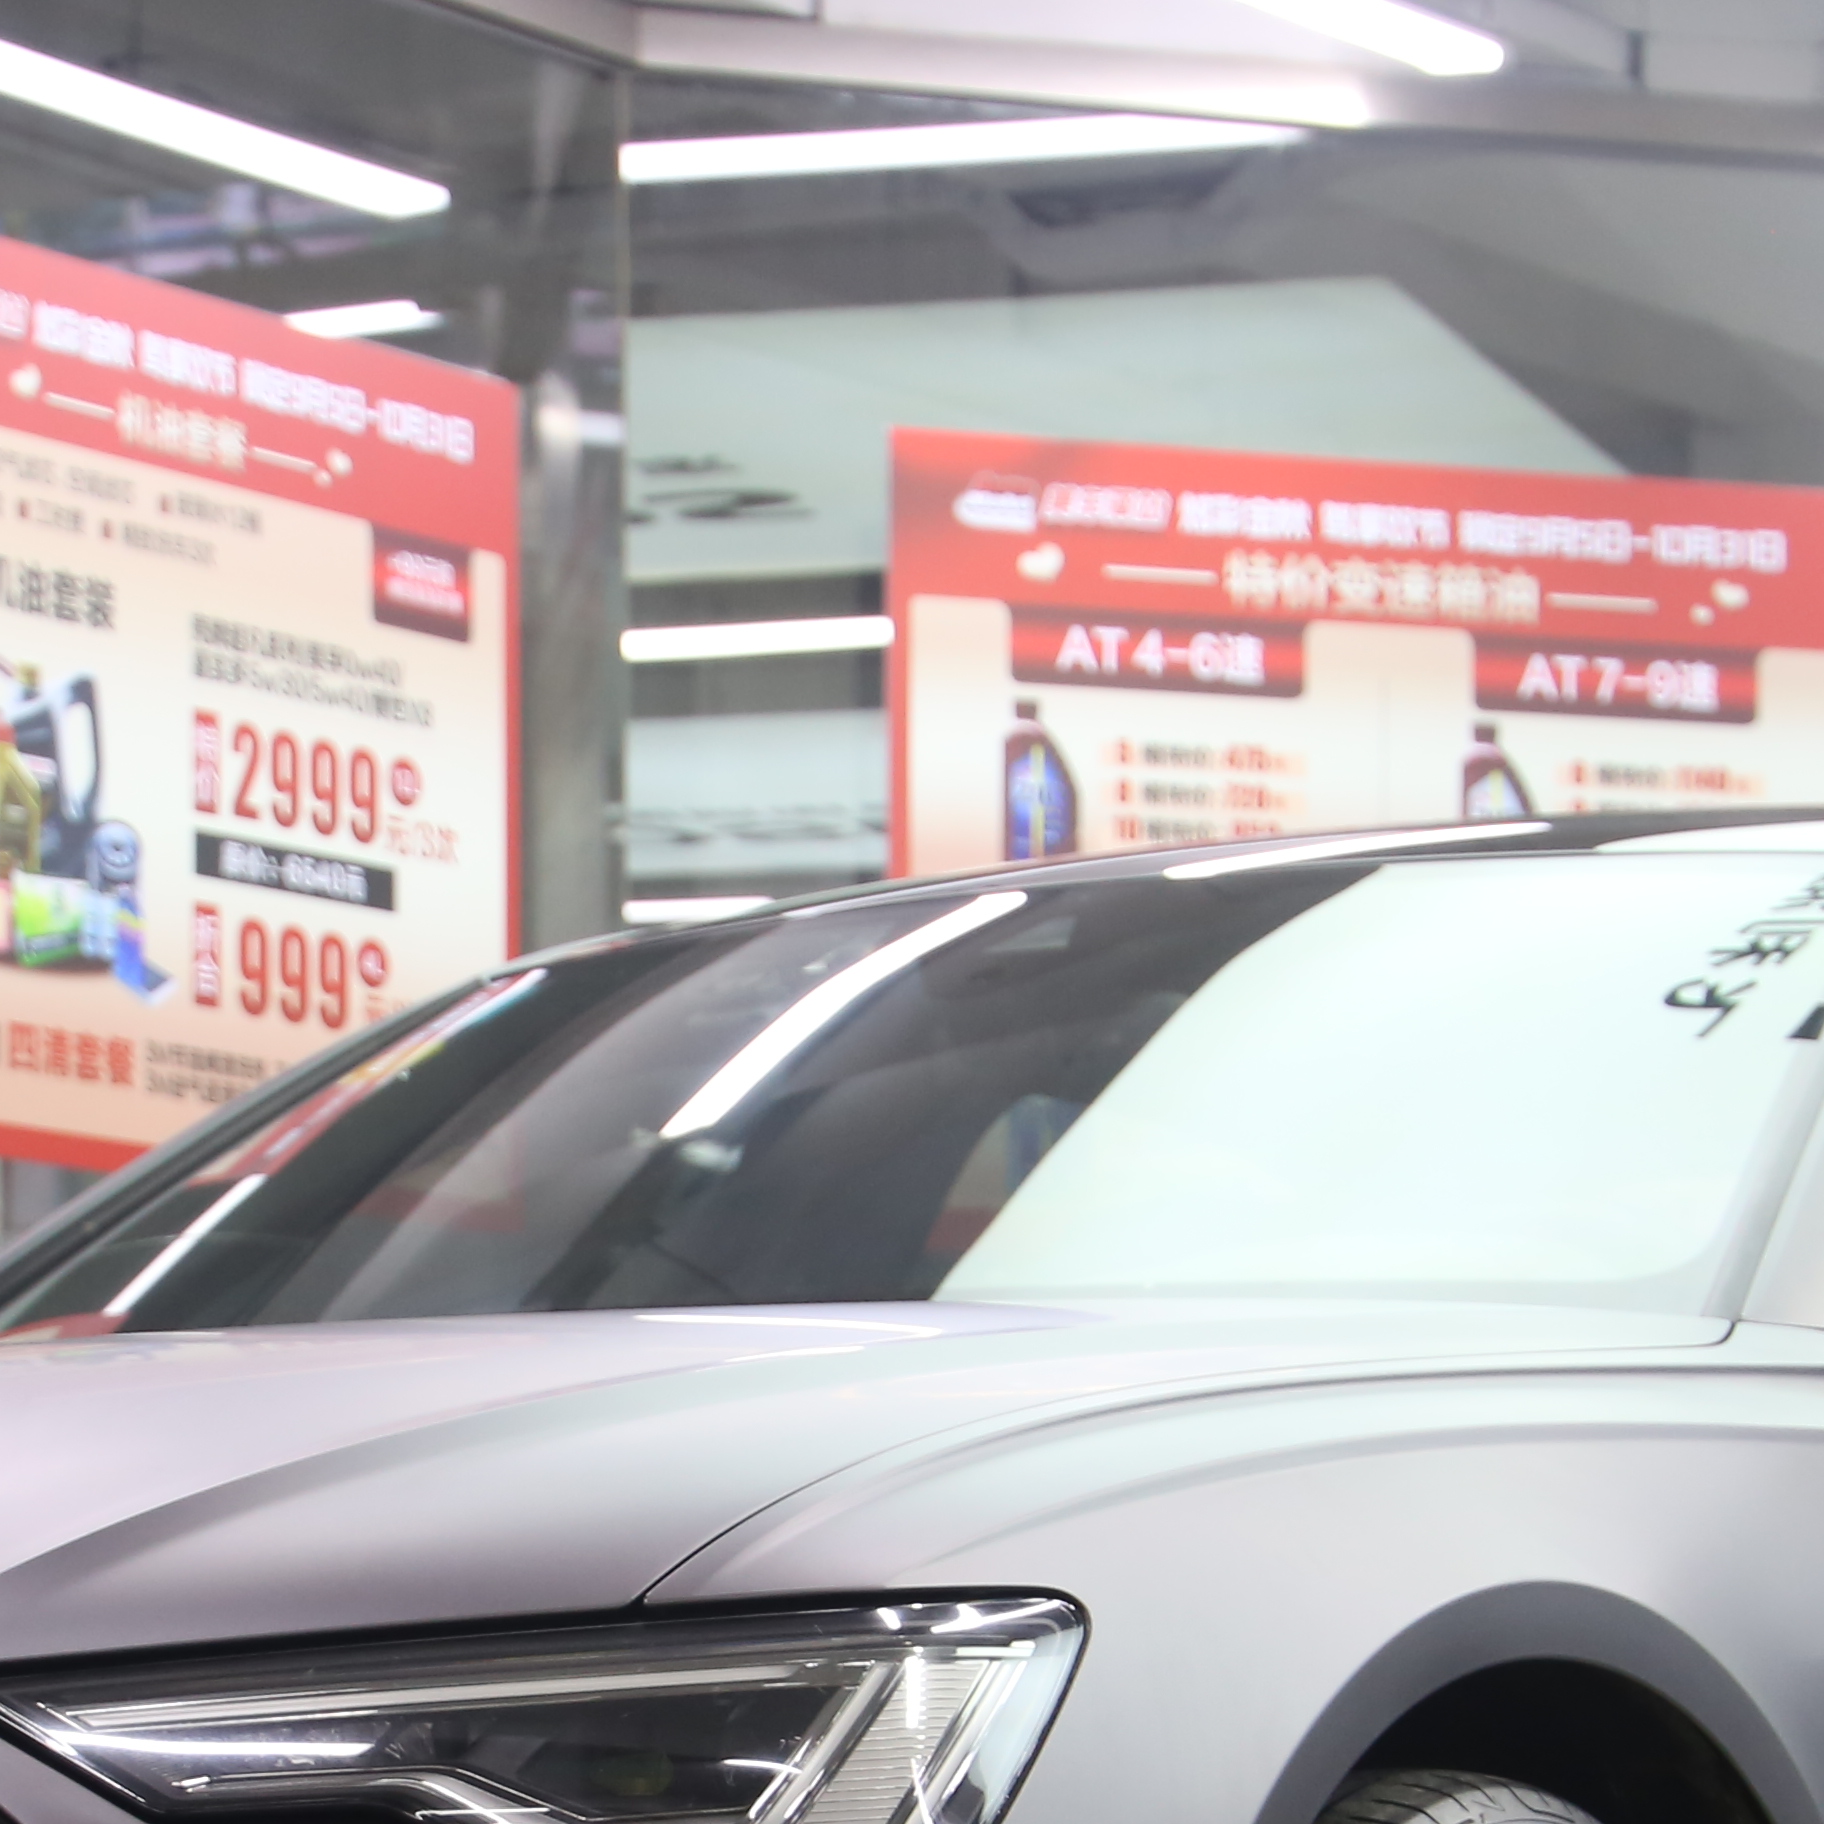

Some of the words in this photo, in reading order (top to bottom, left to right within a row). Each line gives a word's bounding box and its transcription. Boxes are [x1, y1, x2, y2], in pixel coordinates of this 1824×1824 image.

[113, 391, 248, 474] 机油套餐
[1223, 548, 1541, 626] 特价变速箱油
[1055, 623, 1129, 675] AT
[1130, 627, 1265, 686] 4-6速
[1516, 651, 1587, 704] AT
[1590, 656, 1719, 713] 7-9速
[233, 725, 375, 843] 2999
[241, 921, 344, 1028] 999
[8, 1020, 136, 1086] 四清套餐
